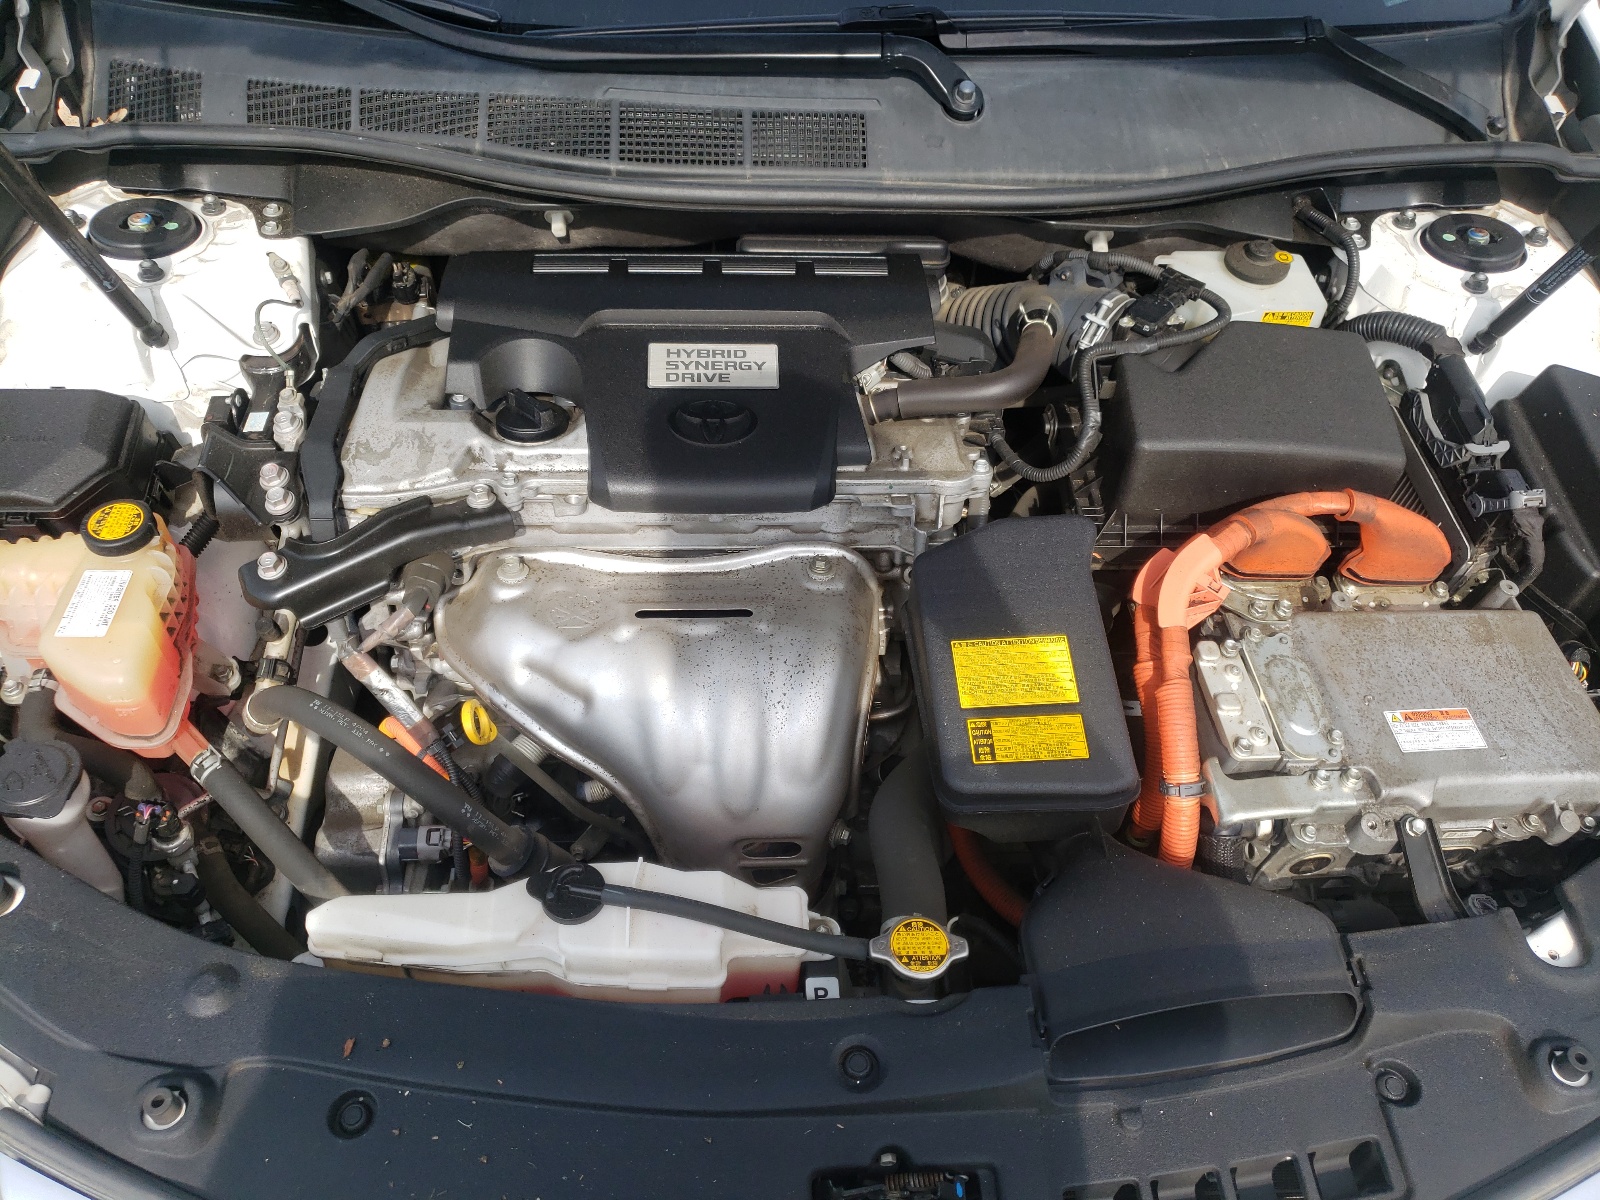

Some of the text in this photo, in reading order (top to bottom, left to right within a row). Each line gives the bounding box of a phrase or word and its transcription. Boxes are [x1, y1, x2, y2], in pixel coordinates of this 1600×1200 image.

[666, 349, 747, 359] HYBRID
[665, 360, 767, 371] SYNERGY
[665, 372, 731, 383] DRIVE
